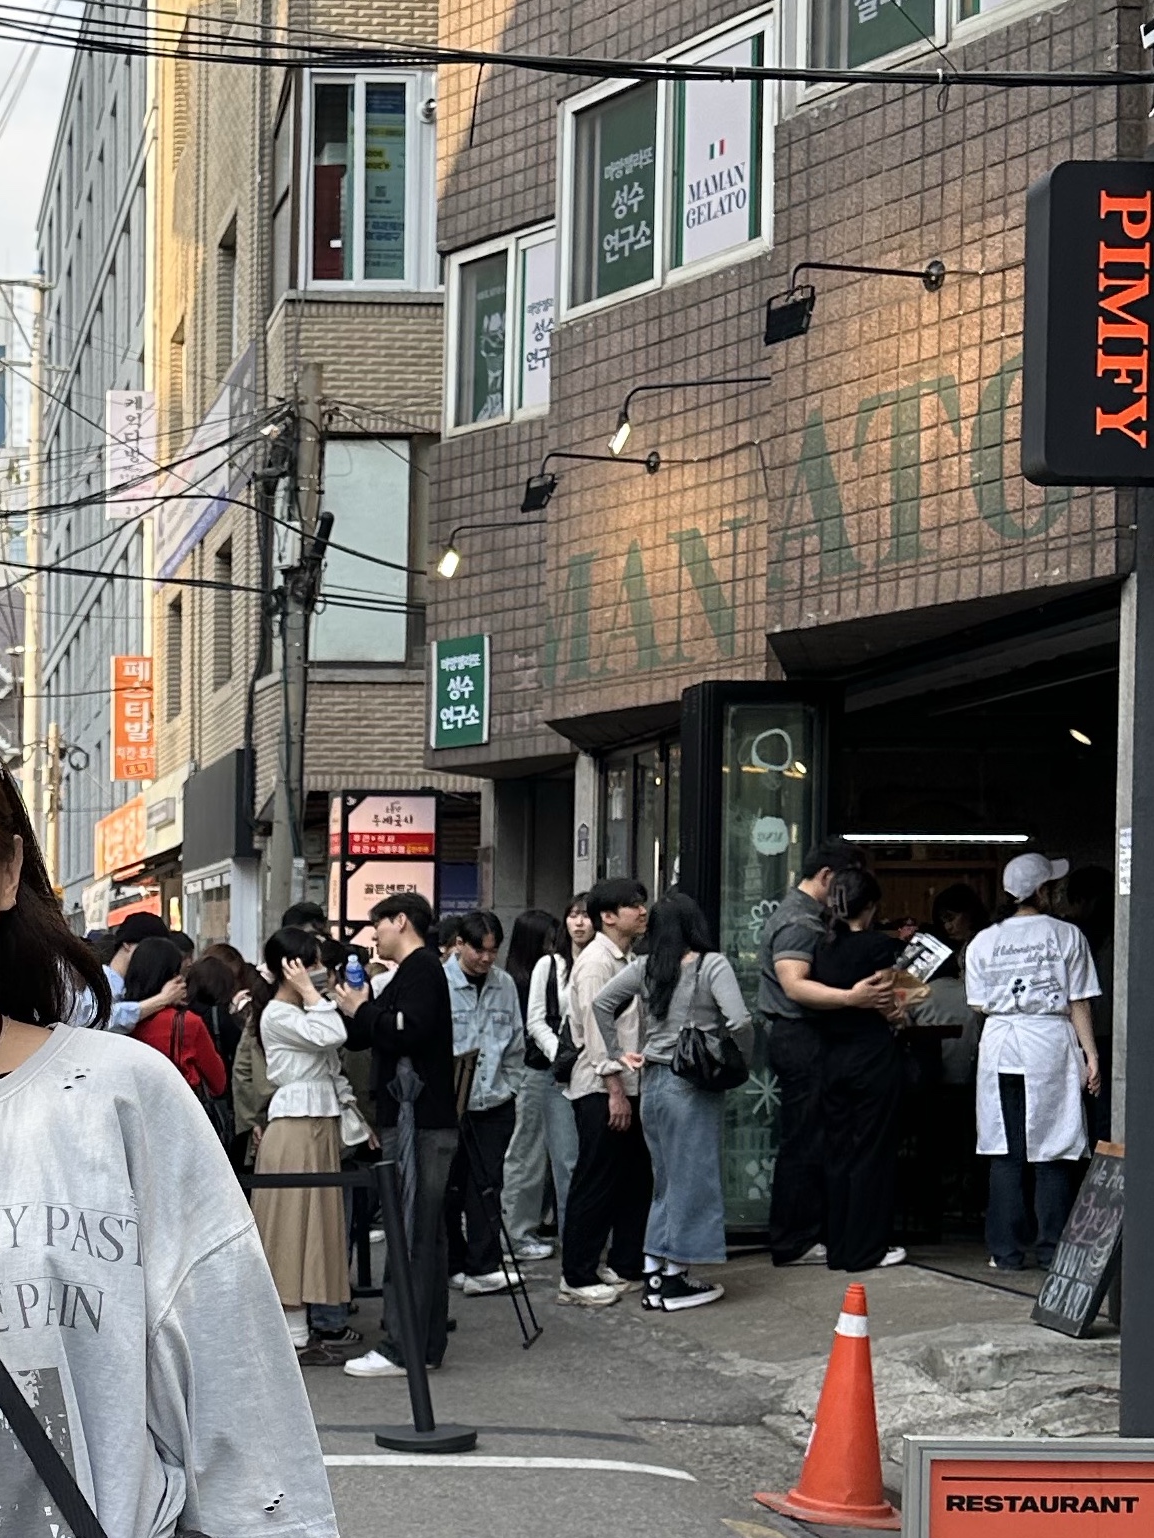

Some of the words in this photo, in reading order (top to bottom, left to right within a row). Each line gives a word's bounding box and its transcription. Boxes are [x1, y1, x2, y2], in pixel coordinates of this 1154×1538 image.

[611, 182, 645, 220] 성수
[687, 162, 746, 206] MAMAN
[685, 188, 747, 230] GELATO
[603, 220, 652, 263] 연구소
[1096, 189, 1152, 449] PIMFY
[122, 661, 152, 742] 페스티발
[446, 675, 475, 700] 성수
[439, 704, 480, 730] 연구소
[44, 1205, 143, 1267] PAST
[946, 1494, 1140, 1514] RESTAURANT
